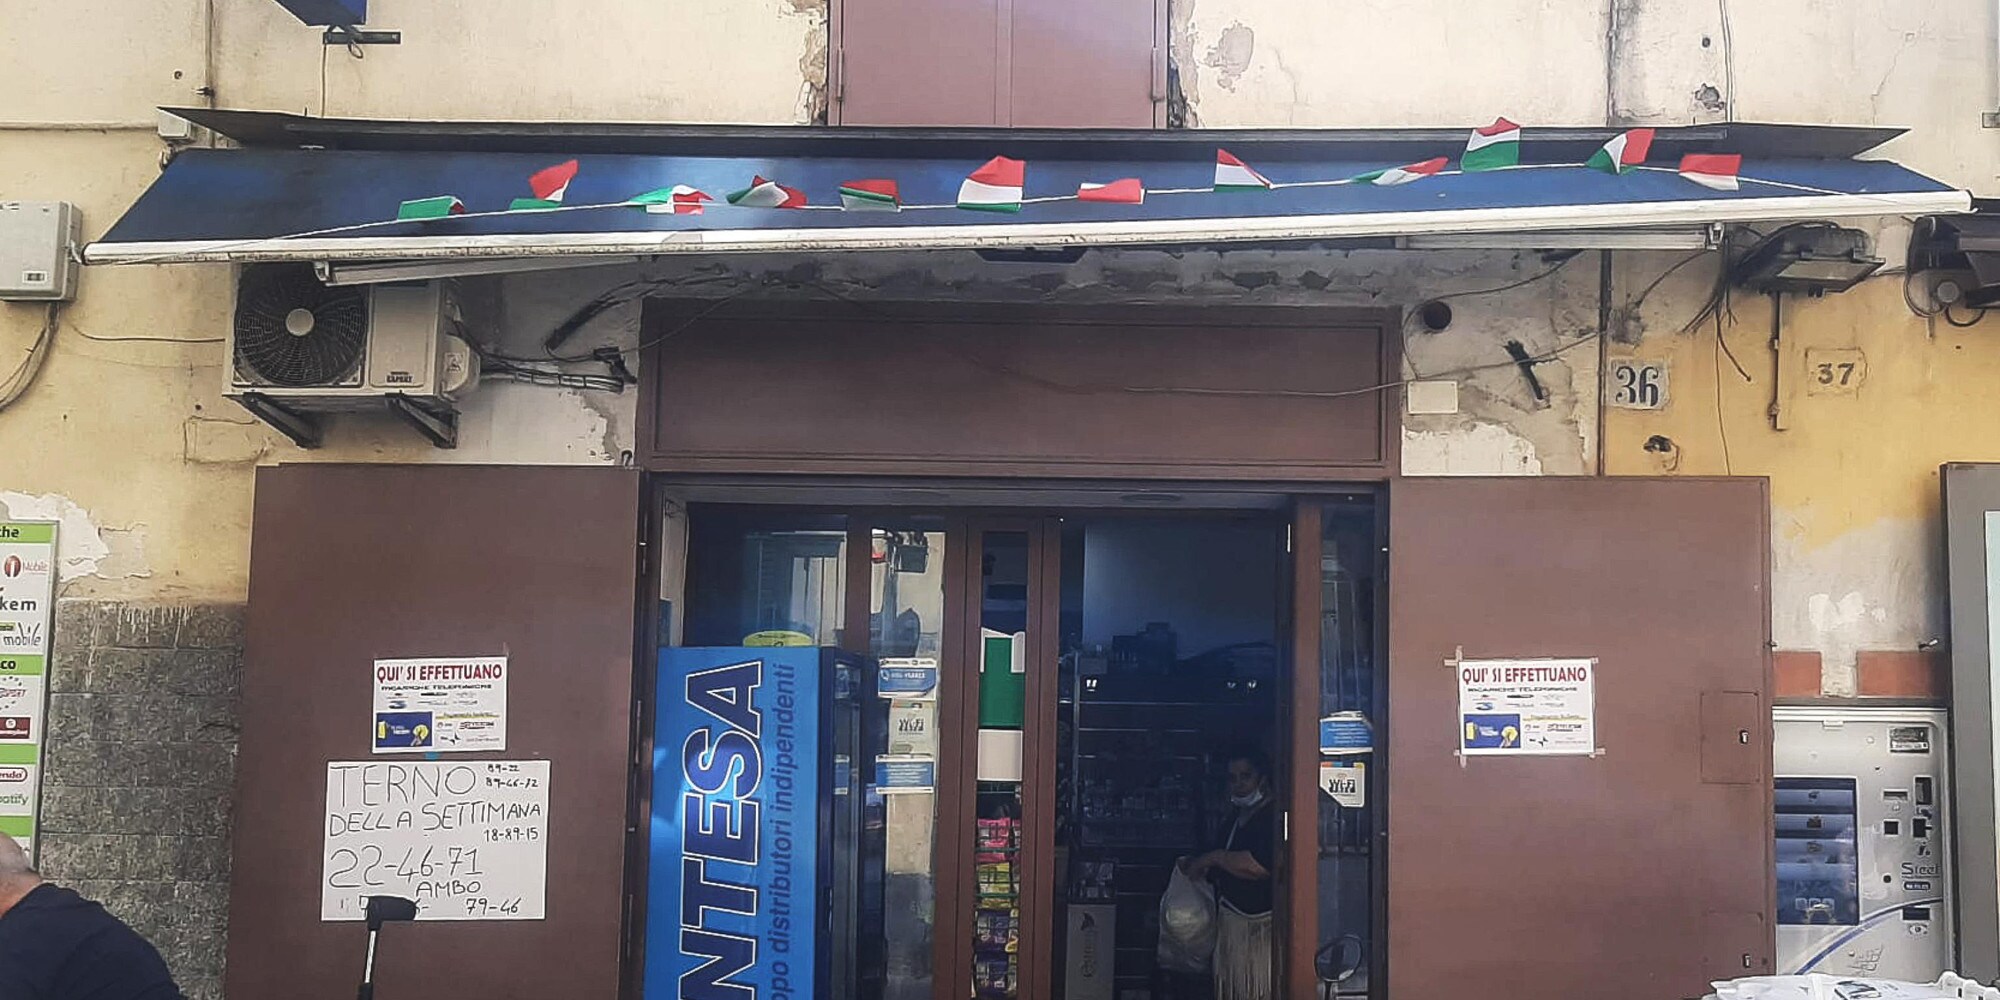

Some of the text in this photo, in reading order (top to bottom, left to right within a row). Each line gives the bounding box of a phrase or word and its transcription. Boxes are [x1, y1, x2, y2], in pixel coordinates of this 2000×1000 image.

[1616, 366, 1660, 407] 36
[1818, 363, 1855, 385] 37
[0, 526, 20, 538] he
[376, 664, 503, 684] QUI' SI EFFETTUANO
[1462, 667, 1587, 685] QUI' SI EFFETTUANO
[770, 664, 799, 812] indipendenti
[330, 764, 476, 806] TERNO
[330, 801, 541, 837] DELLA SETTIMANA
[678, 660, 763, 1000] NTESA
[484, 828, 539, 842] 18-89-15
[328, 845, 483, 888] 22-46-71
[416, 882, 481, 897] AMBO
[768, 819, 792, 953] distributori
[466, 898, 522, 915] 79-46
